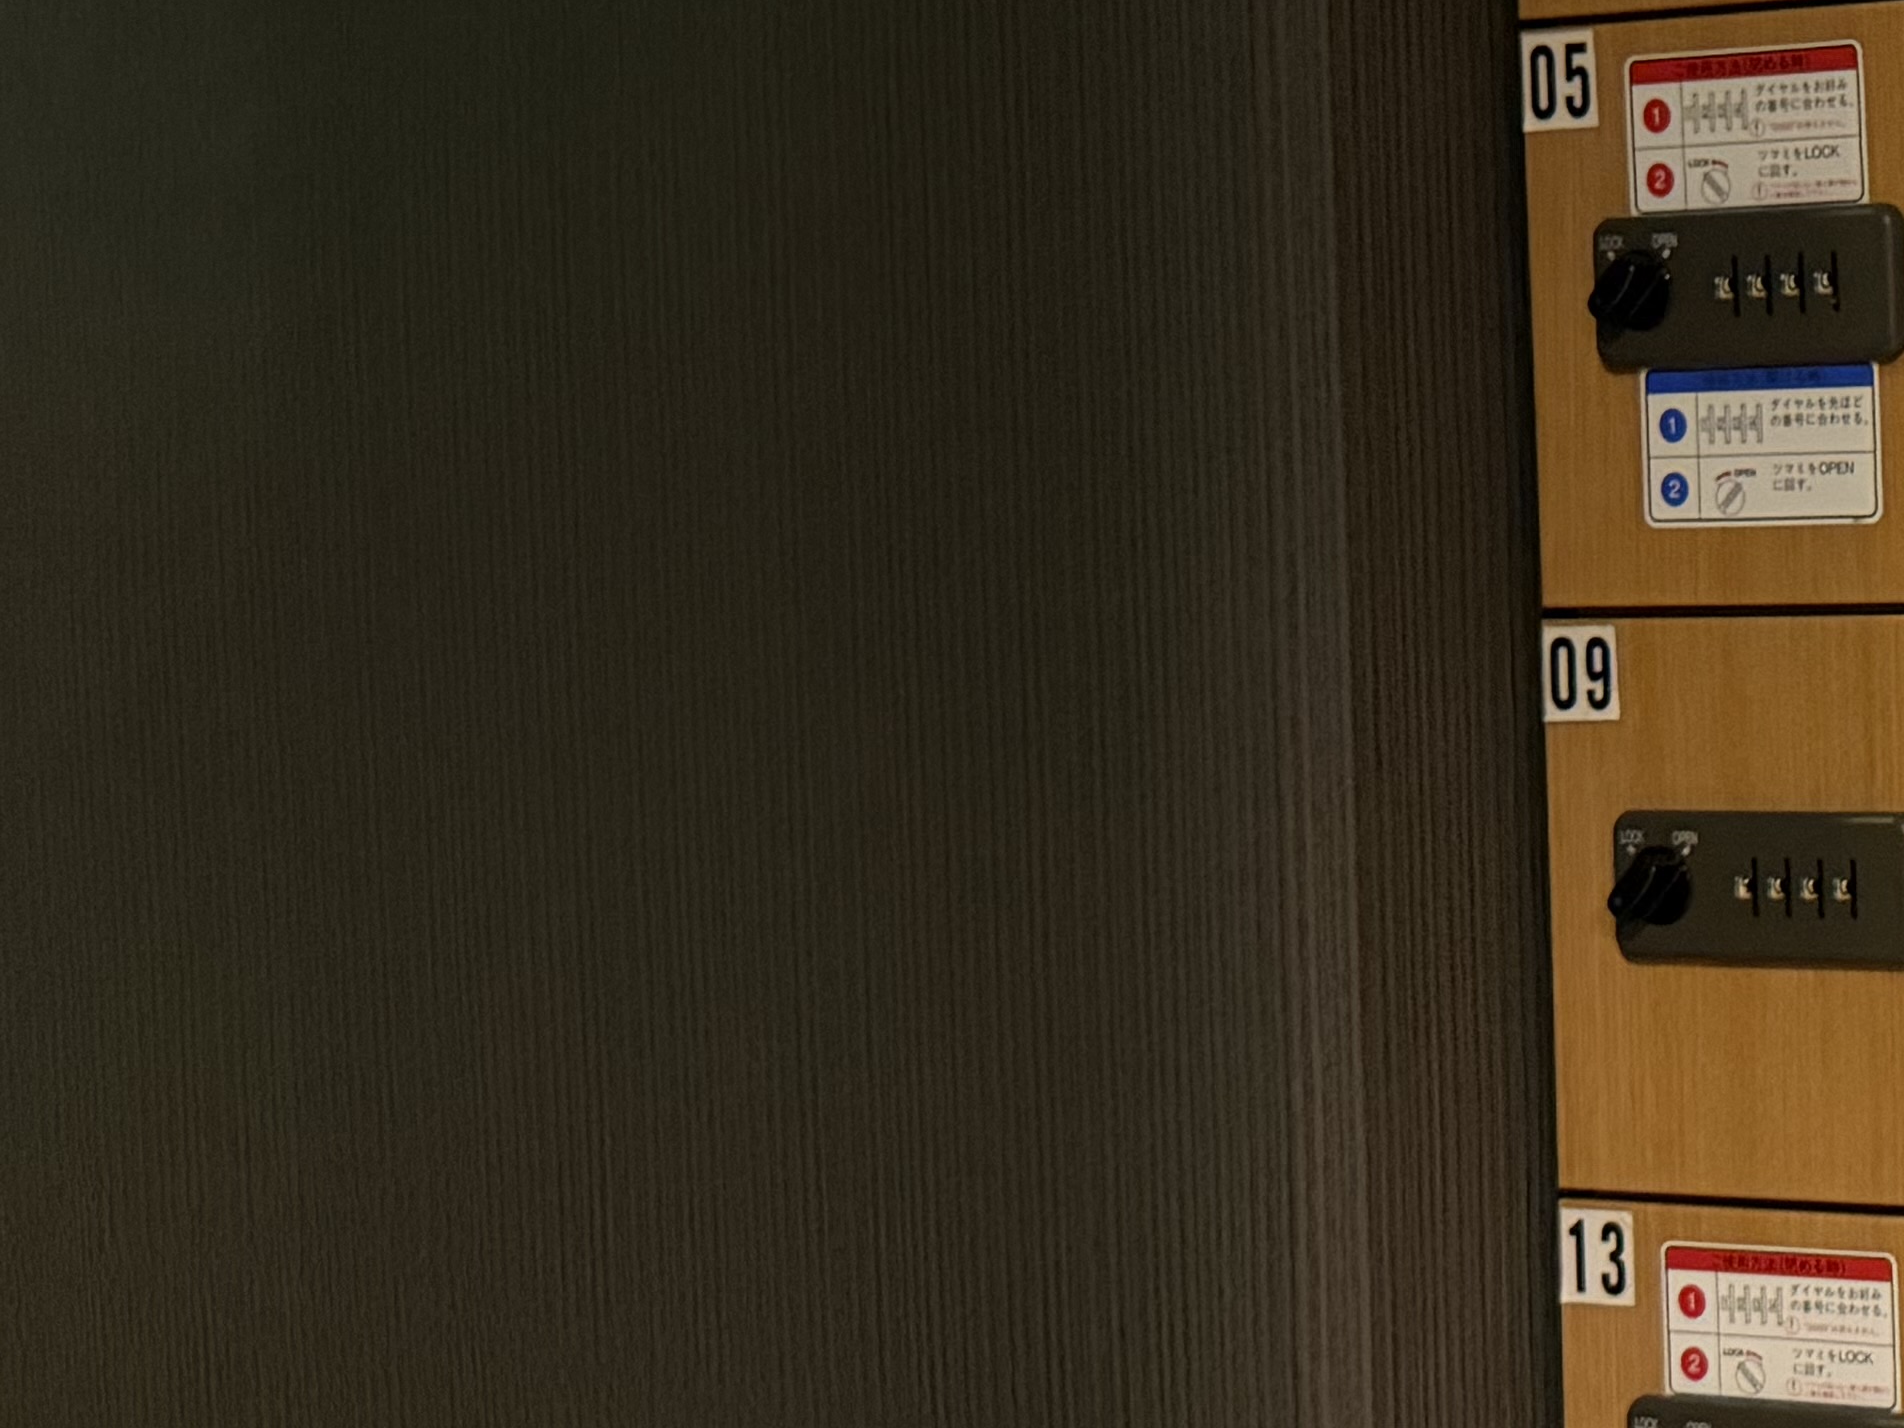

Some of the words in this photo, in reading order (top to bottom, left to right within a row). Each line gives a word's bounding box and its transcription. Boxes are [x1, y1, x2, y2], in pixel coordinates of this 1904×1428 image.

[1530, 42, 1591, 120] 05
[1550, 637, 1612, 710] 09
[1568, 1219, 1626, 1296] 13
